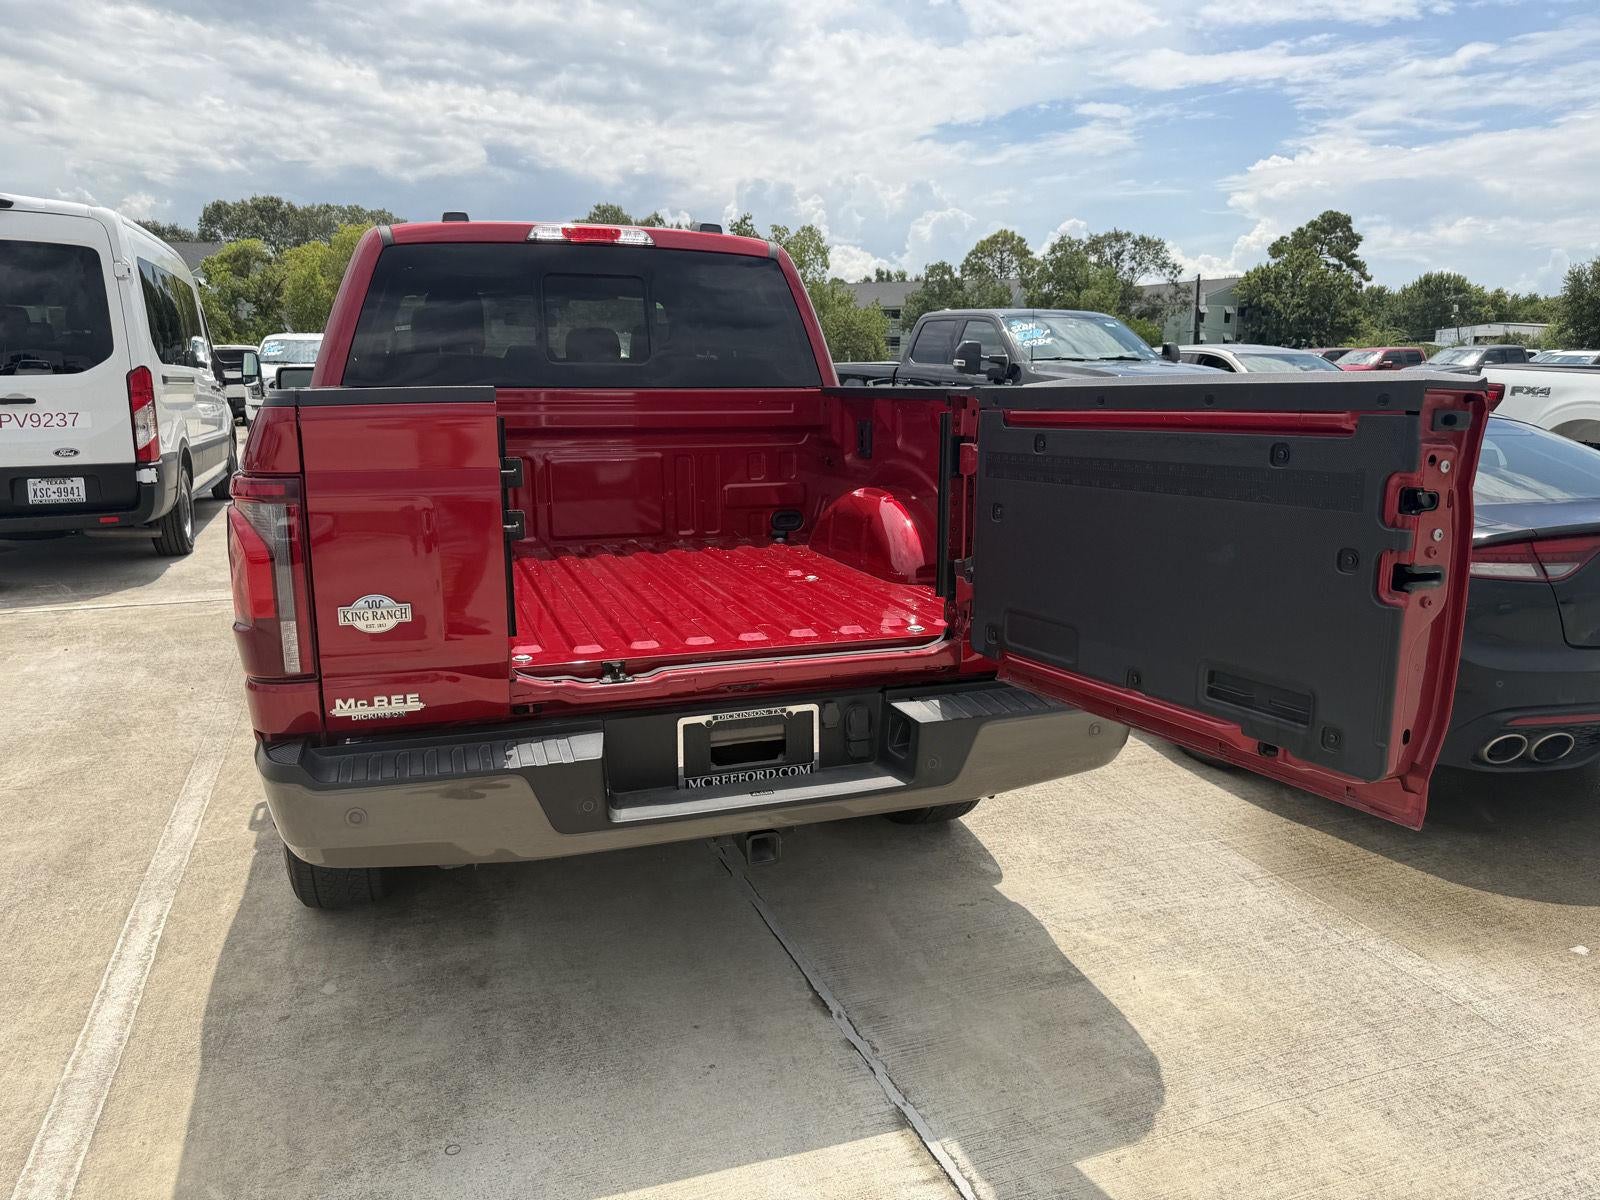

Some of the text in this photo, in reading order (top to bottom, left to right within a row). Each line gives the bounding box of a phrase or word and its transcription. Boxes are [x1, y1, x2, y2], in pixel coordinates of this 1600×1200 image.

[0, 412, 79, 428] PV9237
[342, 607, 408, 622] KING RANCH
[351, 711, 407, 721] DICKINSON
